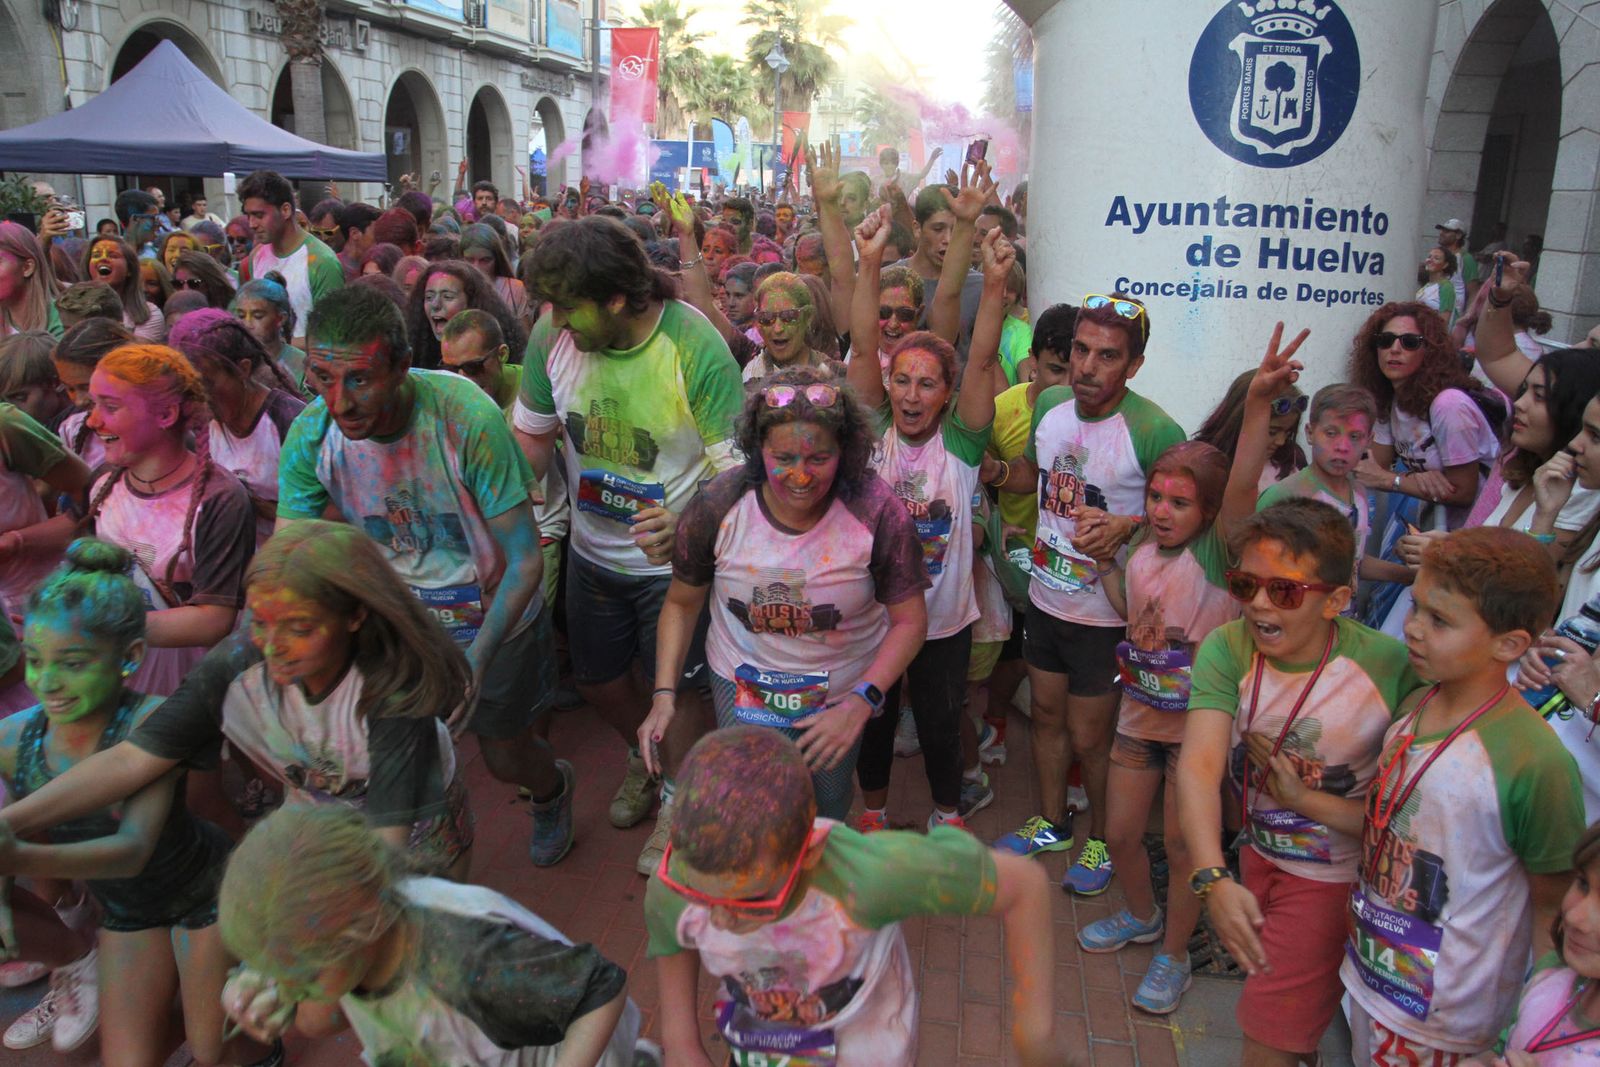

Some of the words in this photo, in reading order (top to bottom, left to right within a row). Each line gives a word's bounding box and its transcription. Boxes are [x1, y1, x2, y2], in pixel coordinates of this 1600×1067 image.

[1262, 45, 1273, 53] ET
[1275, 45, 1302, 54] TERRA
[1244, 57, 1254, 84] MARIS
[1241, 85, 1251, 120] PORTUS
[1304, 69, 1315, 112] CUSTODIA
[1104, 195, 1389, 236] Ayuntamiento
[1186, 235, 1242, 268] de
[1258, 237, 1385, 276] Huelva
[1114, 277, 1248, 302] Concejalía
[1257, 282, 1288, 300] de
[1296, 283, 1384, 306] Deportes
[601, 490, 639, 511] 694
[1054, 556, 1072, 576] 15
[751, 604, 812, 619] MUSIC
[1139, 670, 1160, 691] 99
[760, 690, 802, 711] 706
[1161, 700, 1188, 710] Color
[1371, 916, 1405, 936] HUELVA
[1356, 927, 1397, 974] 114
[1383, 984, 1425, 1016] Colors
